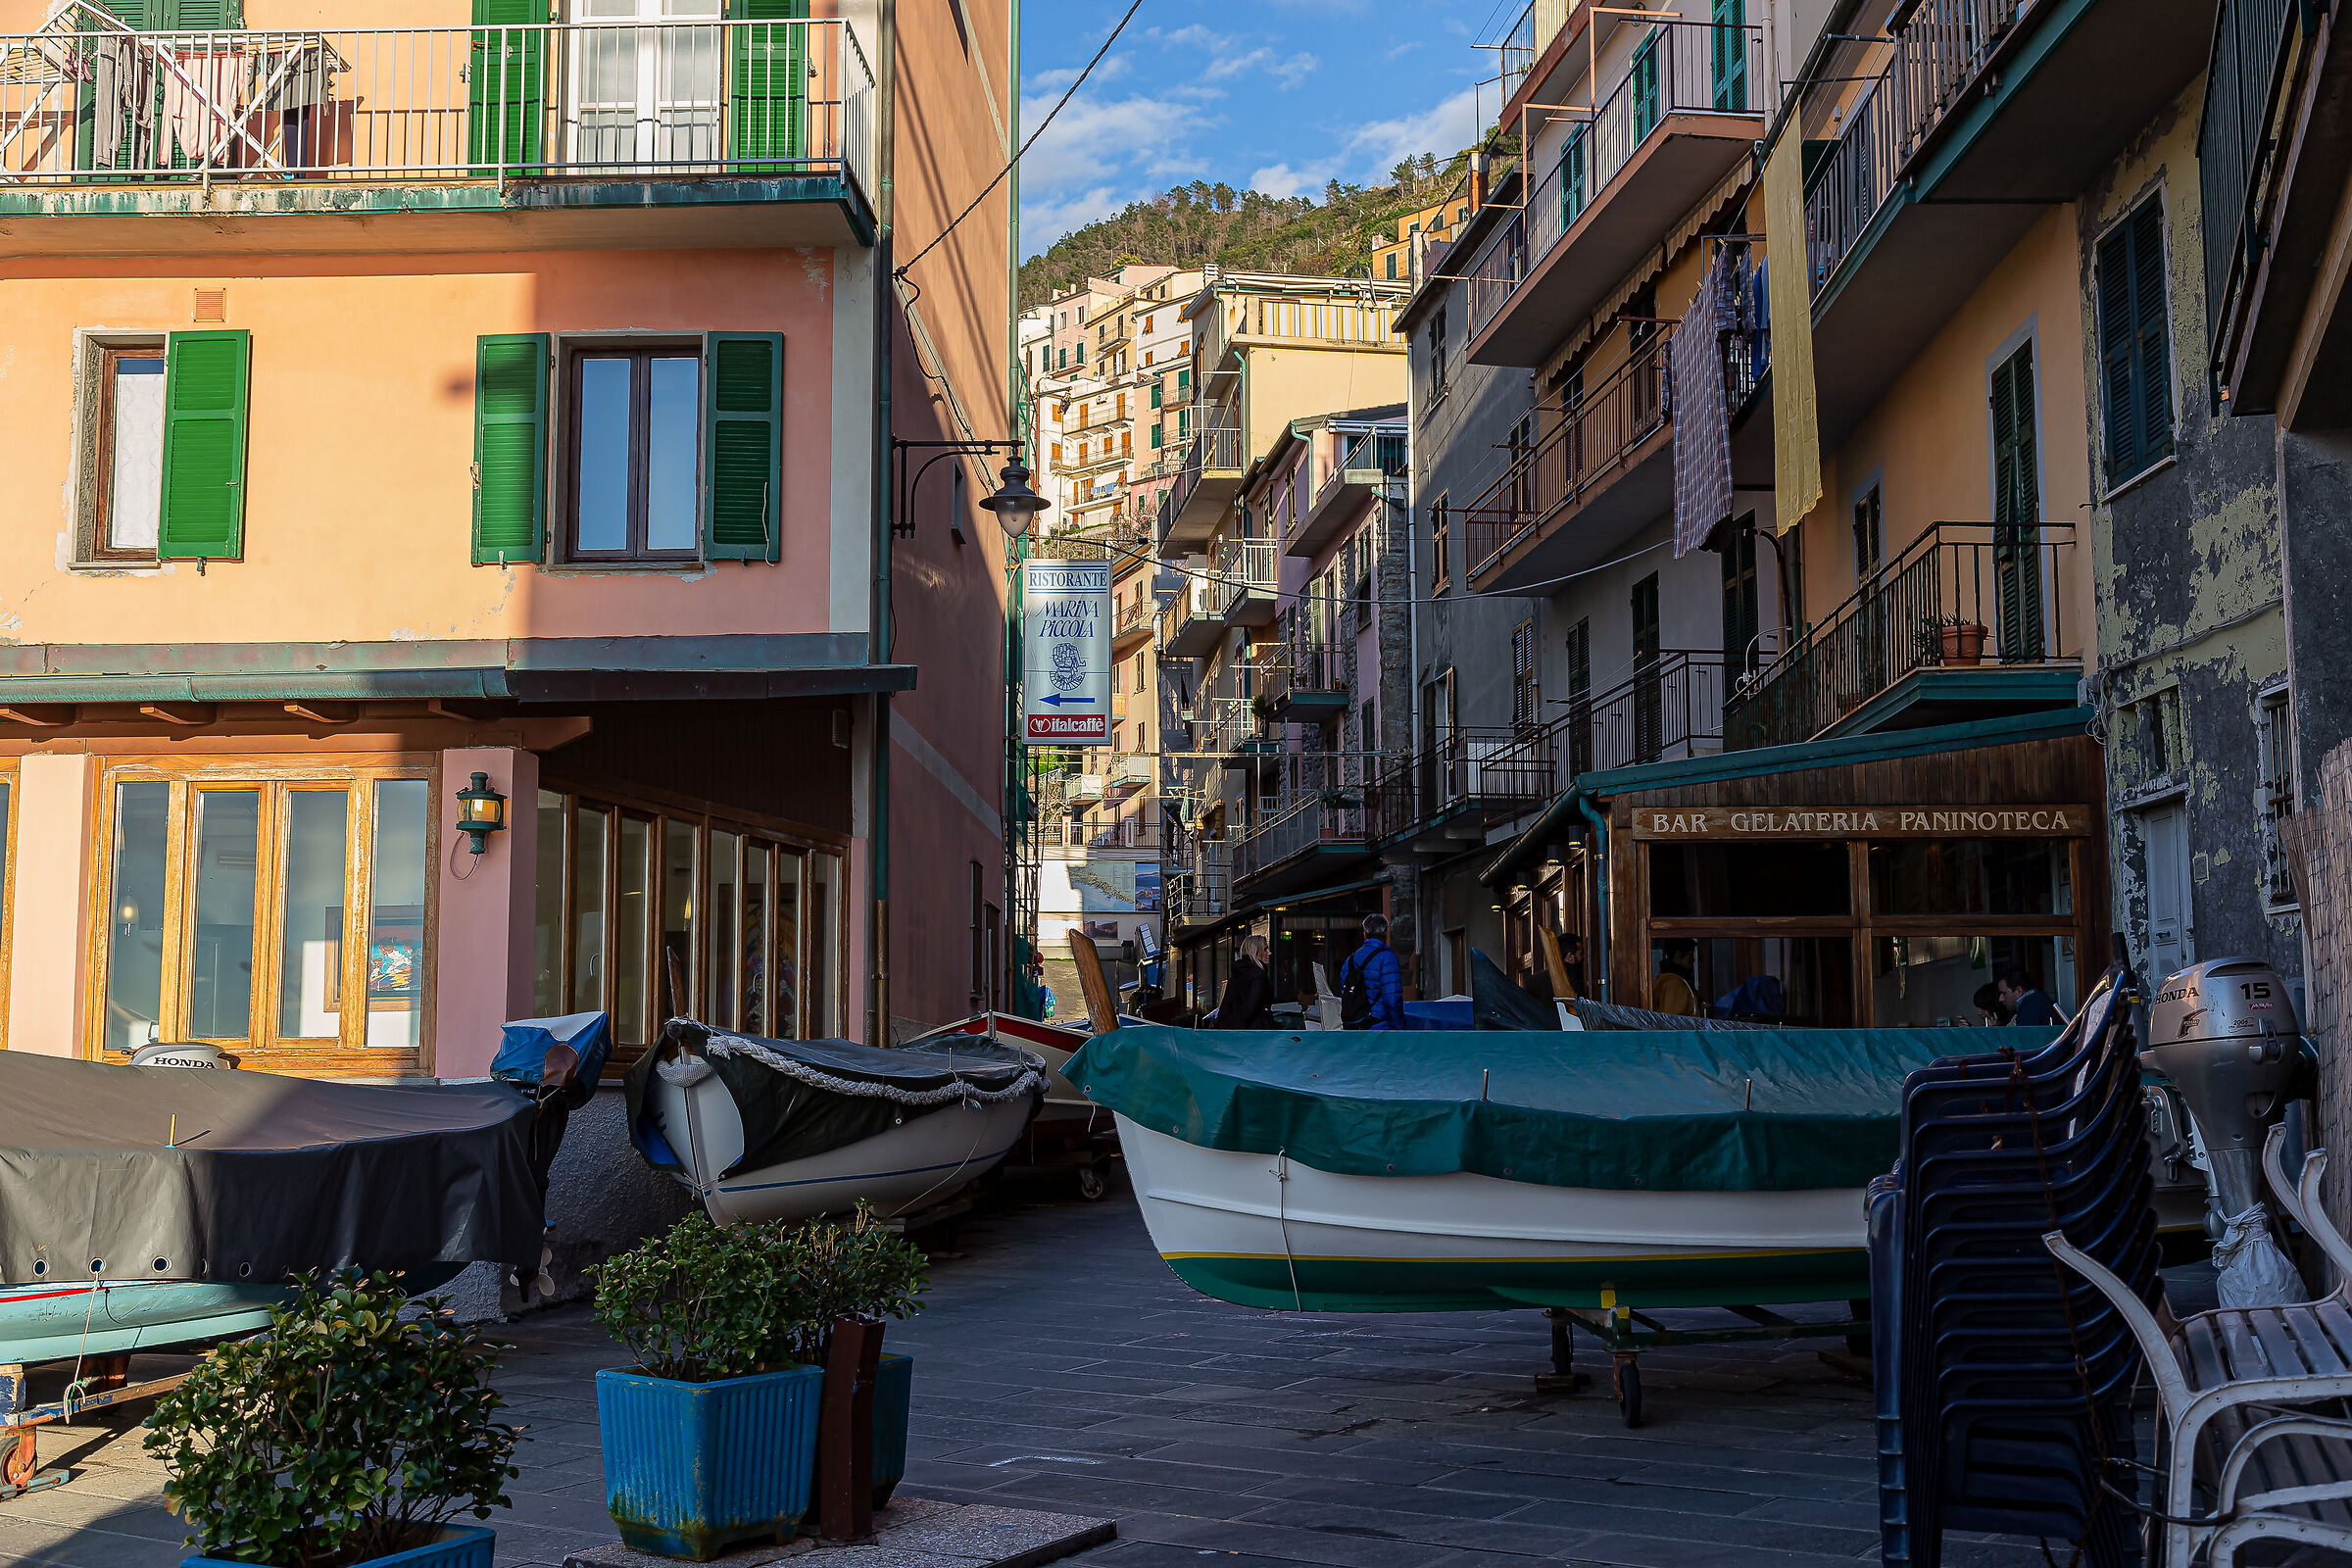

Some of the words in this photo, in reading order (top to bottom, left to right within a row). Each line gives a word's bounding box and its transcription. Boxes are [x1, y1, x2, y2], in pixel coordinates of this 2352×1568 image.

[1029, 571, 1107, 587] RISTORANTE
[1051, 717, 1103, 733] italcaffè
[1652, 813, 1708, 833] BAR
[1730, 812, 1880, 832] GELATERIA
[1900, 810, 2070, 831] PANINOTECA
[2155, 987, 2200, 1004] HONDA
[2239, 982, 2271, 1000] 15
[154, 1057, 215, 1069] HONDA
